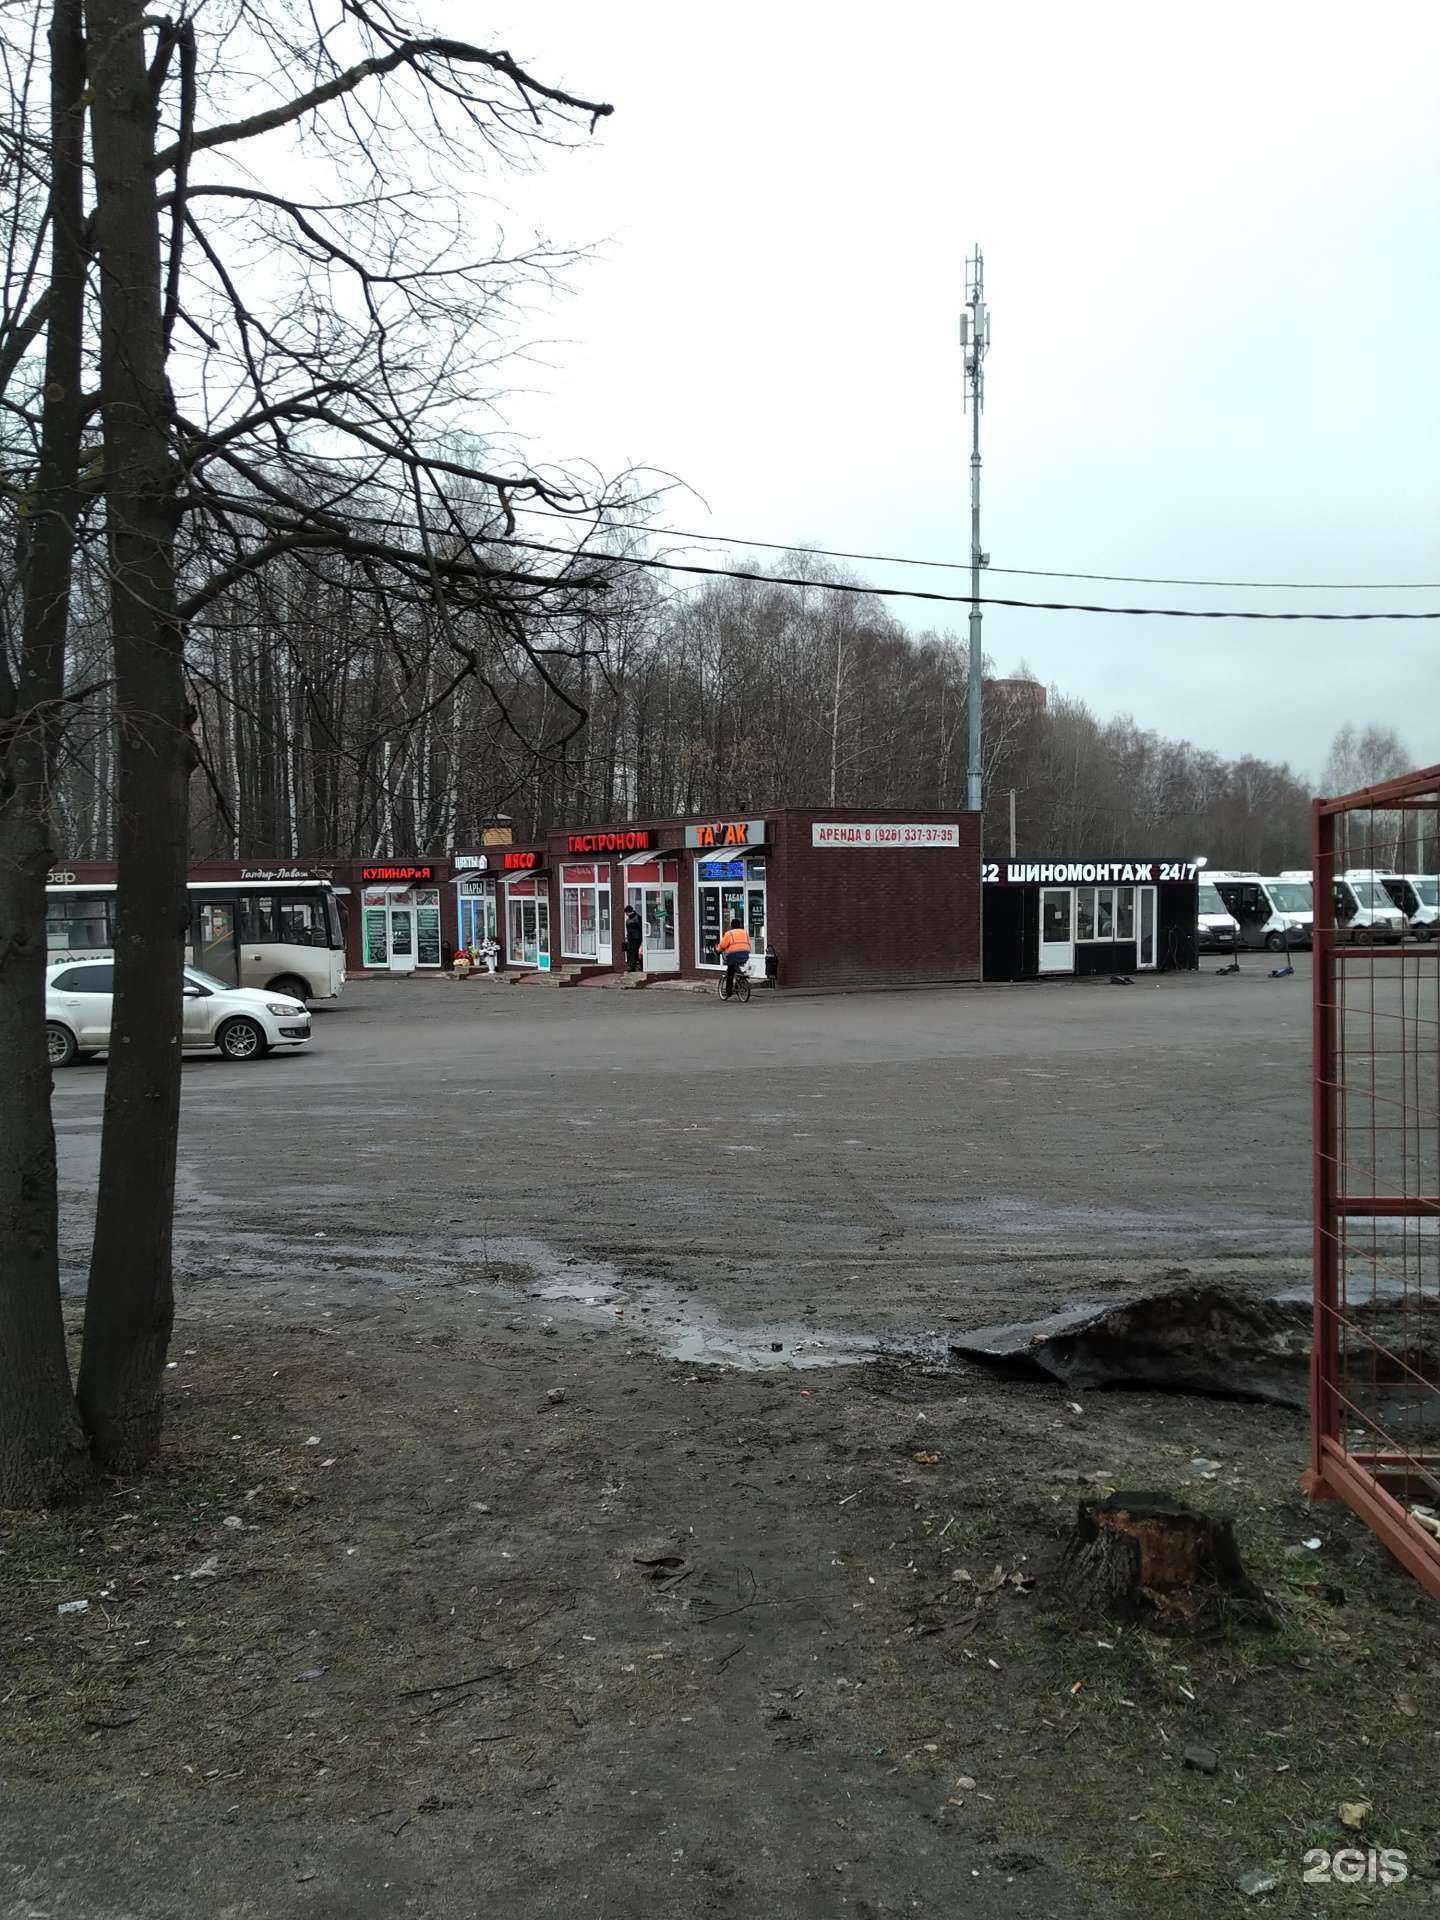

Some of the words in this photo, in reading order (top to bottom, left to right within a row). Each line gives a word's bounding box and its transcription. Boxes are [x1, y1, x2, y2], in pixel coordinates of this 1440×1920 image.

[568, 832, 648, 852] ГАСТРОНОМ
[819, 829, 862, 842] АРЕНДА
[864, 829, 871, 841] 8
[904, 829, 953, 841] 337-37-35
[504, 853, 535, 868] МЯСО
[1007, 863, 1152, 882] ШИНОМОНТАЖ
[1159, 863, 1196, 881] 24/7
[461, 882, 483, 895] ШАРЫ
